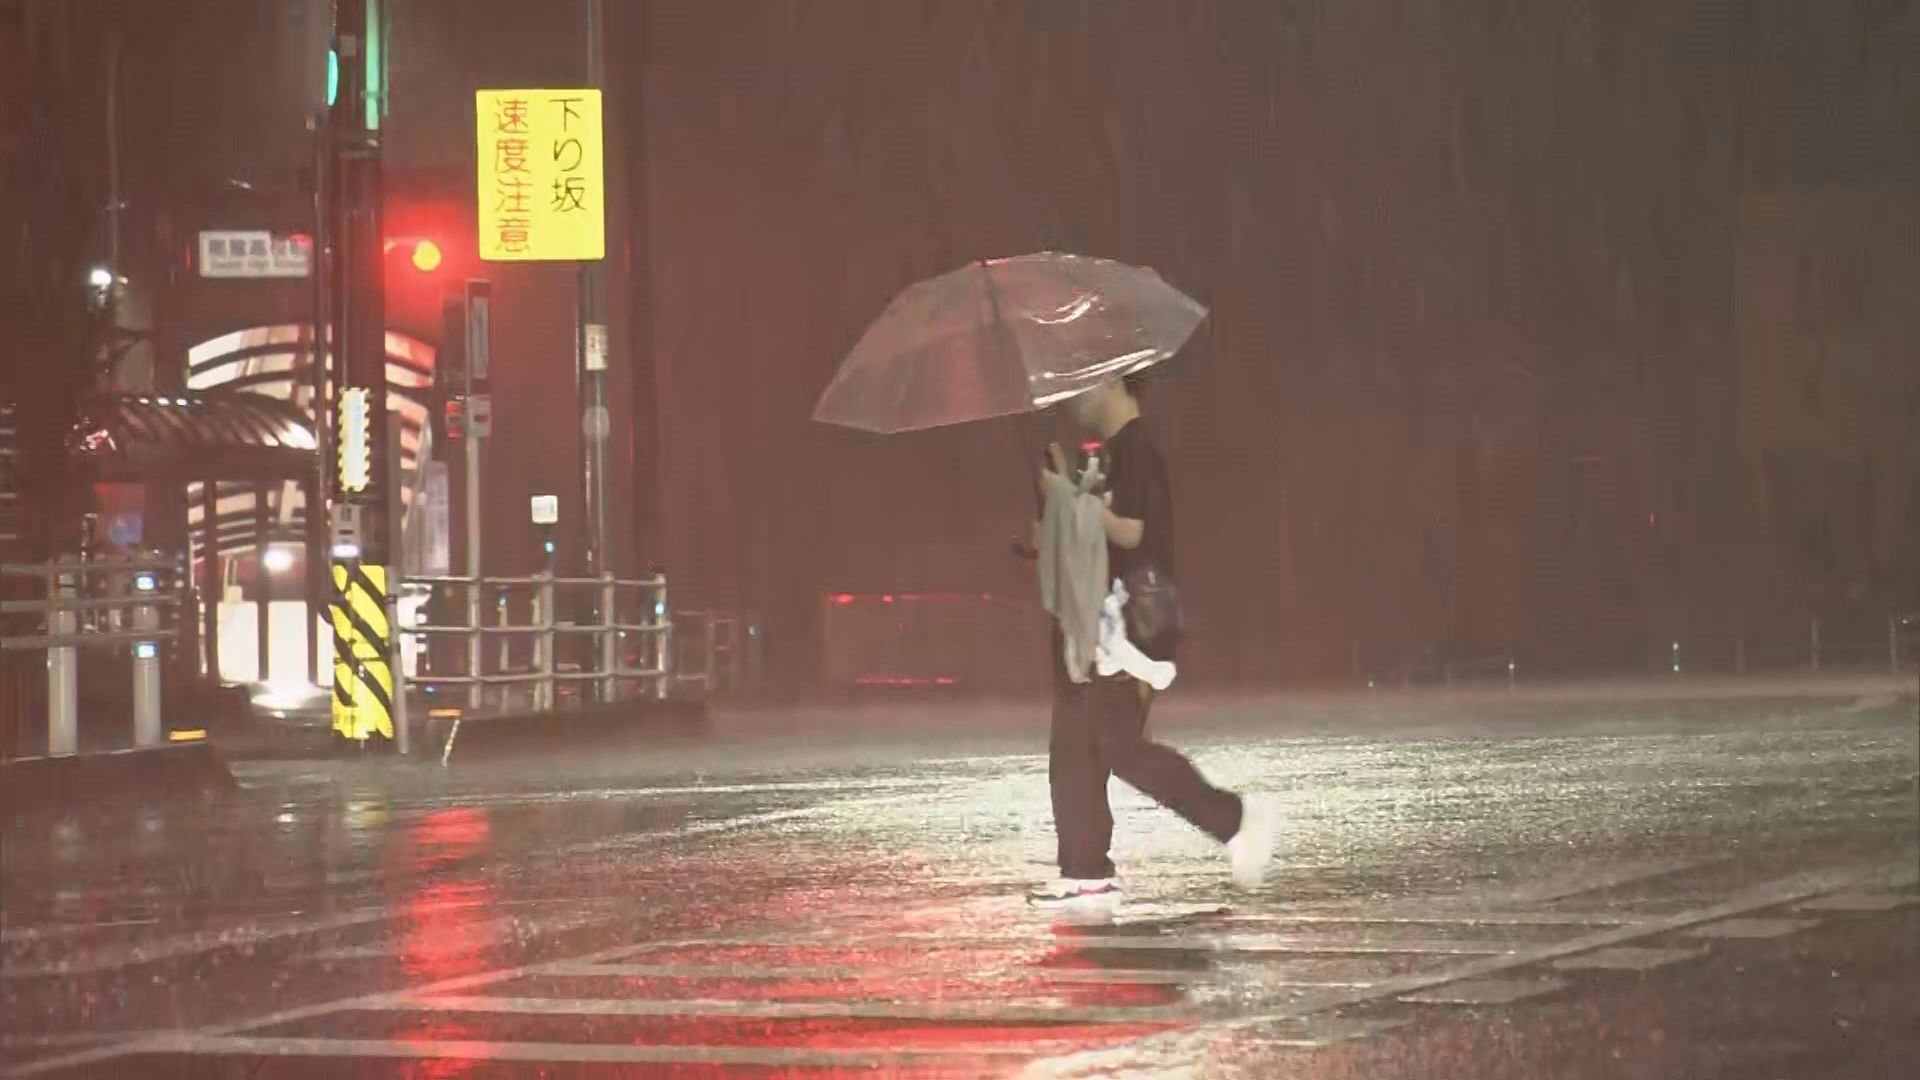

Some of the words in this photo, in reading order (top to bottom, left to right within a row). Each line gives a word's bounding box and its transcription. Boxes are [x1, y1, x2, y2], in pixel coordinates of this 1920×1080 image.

[495, 98, 534, 253] 速度注意
[549, 98, 587, 213] 下り坂
